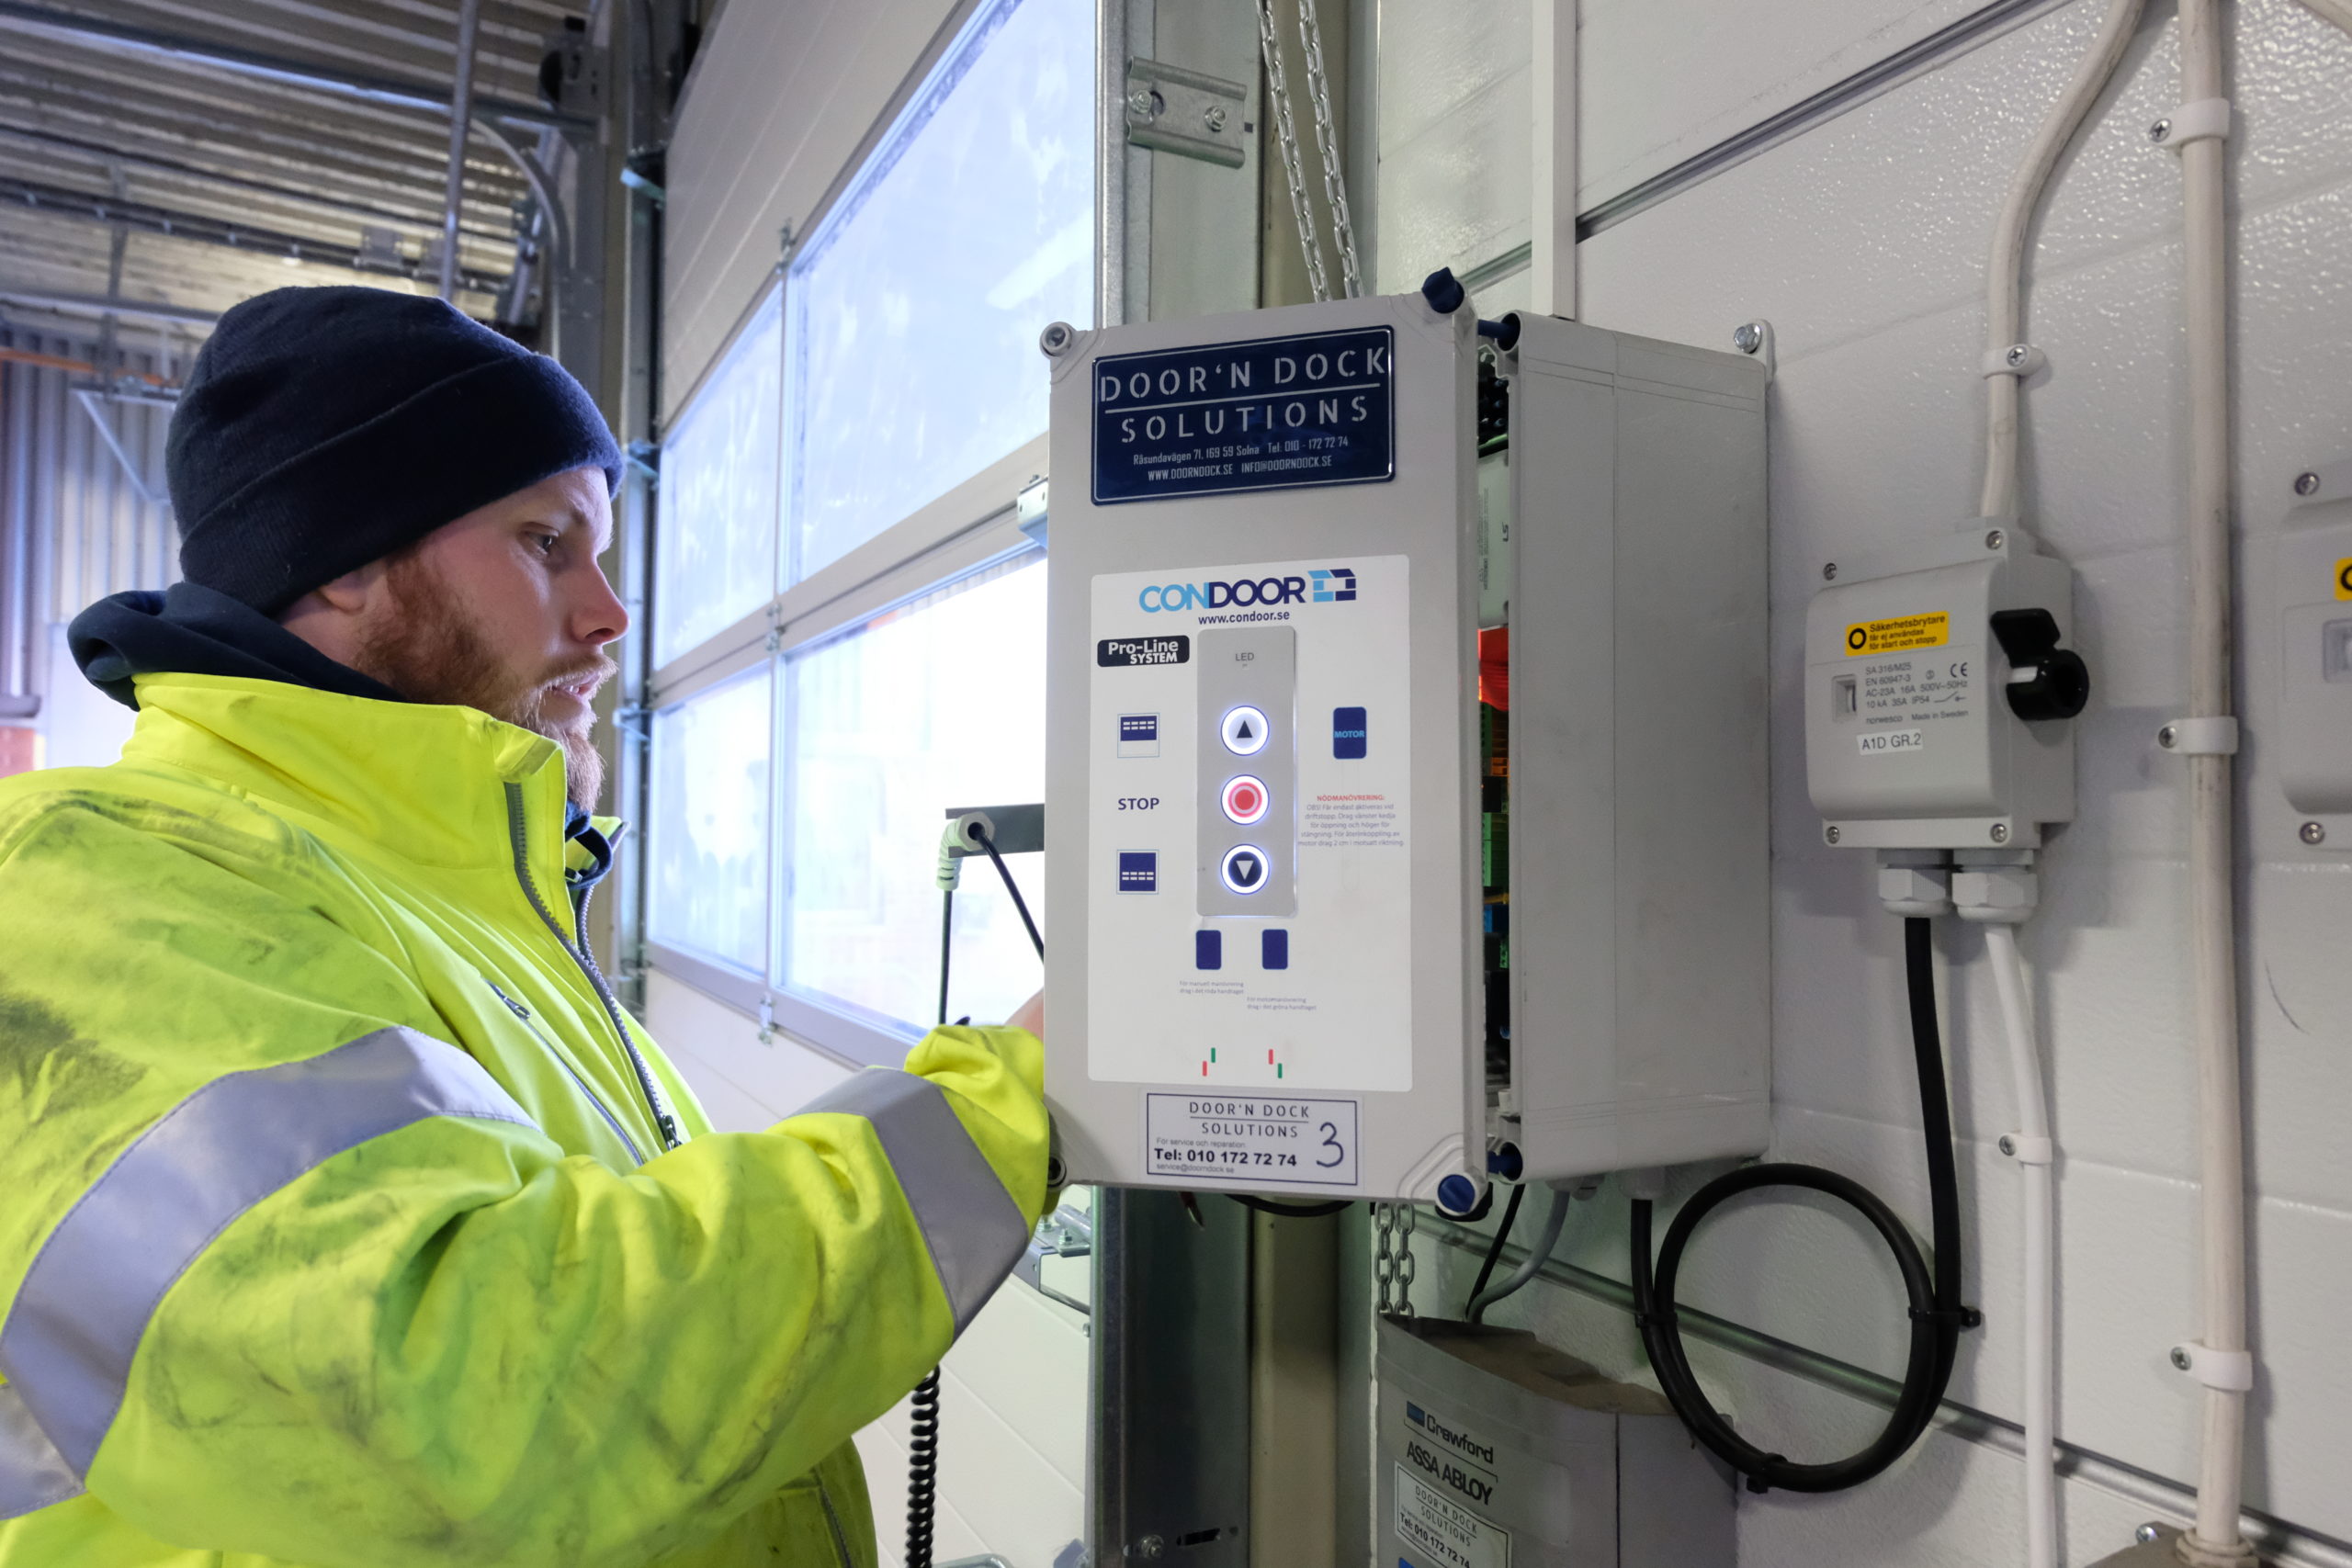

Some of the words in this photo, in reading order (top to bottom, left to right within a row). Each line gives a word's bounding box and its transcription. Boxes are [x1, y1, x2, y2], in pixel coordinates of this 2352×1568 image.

[1100, 360, 1251, 402] DOOR'N
[1274, 346, 1385, 385] DOCK
[1121, 395, 1367, 444] SOLUTIONS
[1133, 451, 1192, 466] Råsundavägen
[1206, 446, 1220, 458] 169
[1222, 446, 1234, 457] 59
[1236, 444, 1260, 457] Solna
[1284, 439, 1300, 452] 010
[1308, 437, 1322, 450] 172
[1324, 436, 1335, 448] 72
[1338, 435, 1349, 447] 74
[1148, 463, 1233, 481] WWW.DOORNDOCK.SE
[1241, 455, 1332, 473] INFO@DOORNDOCK.SE
[1138, 576, 1306, 614] CONDOOR
[1198, 610, 1290, 626] www.condoor.se
[1870, 615, 1946, 633] Säkerhetsbrytare
[1881, 640, 1898, 649] start
[1899, 638, 1914, 647] och
[1916, 636, 1937, 646] stopp
[1889, 628, 1924, 639] användas
[1108, 638, 1179, 656] Pro-Line
[1130, 651, 1178, 665] SYSTEM
[1235, 652, 1255, 661] LED
[1866, 666, 1877, 675] SA
[1866, 677, 1878, 686] EN
[1911, 713, 1930, 721] Made
[1939, 710, 1969, 719] Sweden
[1334, 729, 1365, 739] MOTOR
[1861, 736, 1886, 750] A1D
[1890, 732, 1922, 749] GR.2
[1117, 797, 1160, 810] STOP
[1189, 1101, 1254, 1116] DOOR'N
[1263, 1105, 1309, 1119] DOCK
[1202, 1122, 1298, 1138] SOLUTIONS
[1317, 1122, 1344, 1168] 3
[1154, 1147, 1182, 1161] Tel:
[1187, 1149, 1215, 1163] 010
[1220, 1151, 1249, 1165] 172
[1253, 1153, 1272, 1166] 72
[1277, 1154, 1297, 1167] 74
[1426, 1415, 1495, 1464] Crawford
[1407, 1440, 1441, 1478] ASSA
[1442, 1463, 1493, 1506] ABLOY
[1415, 1484, 1449, 1515] DOOR'N
[1453, 1509, 1477, 1534] DOCK
[1420, 1506, 1471, 1547] SOLUTIONS
[1399, 1512, 1413, 1530] Tel:
[1414, 1524, 1429, 1541] 010
[1430, 1536, 1446, 1553] 172
[1447, 1547, 1458, 1562] 72
